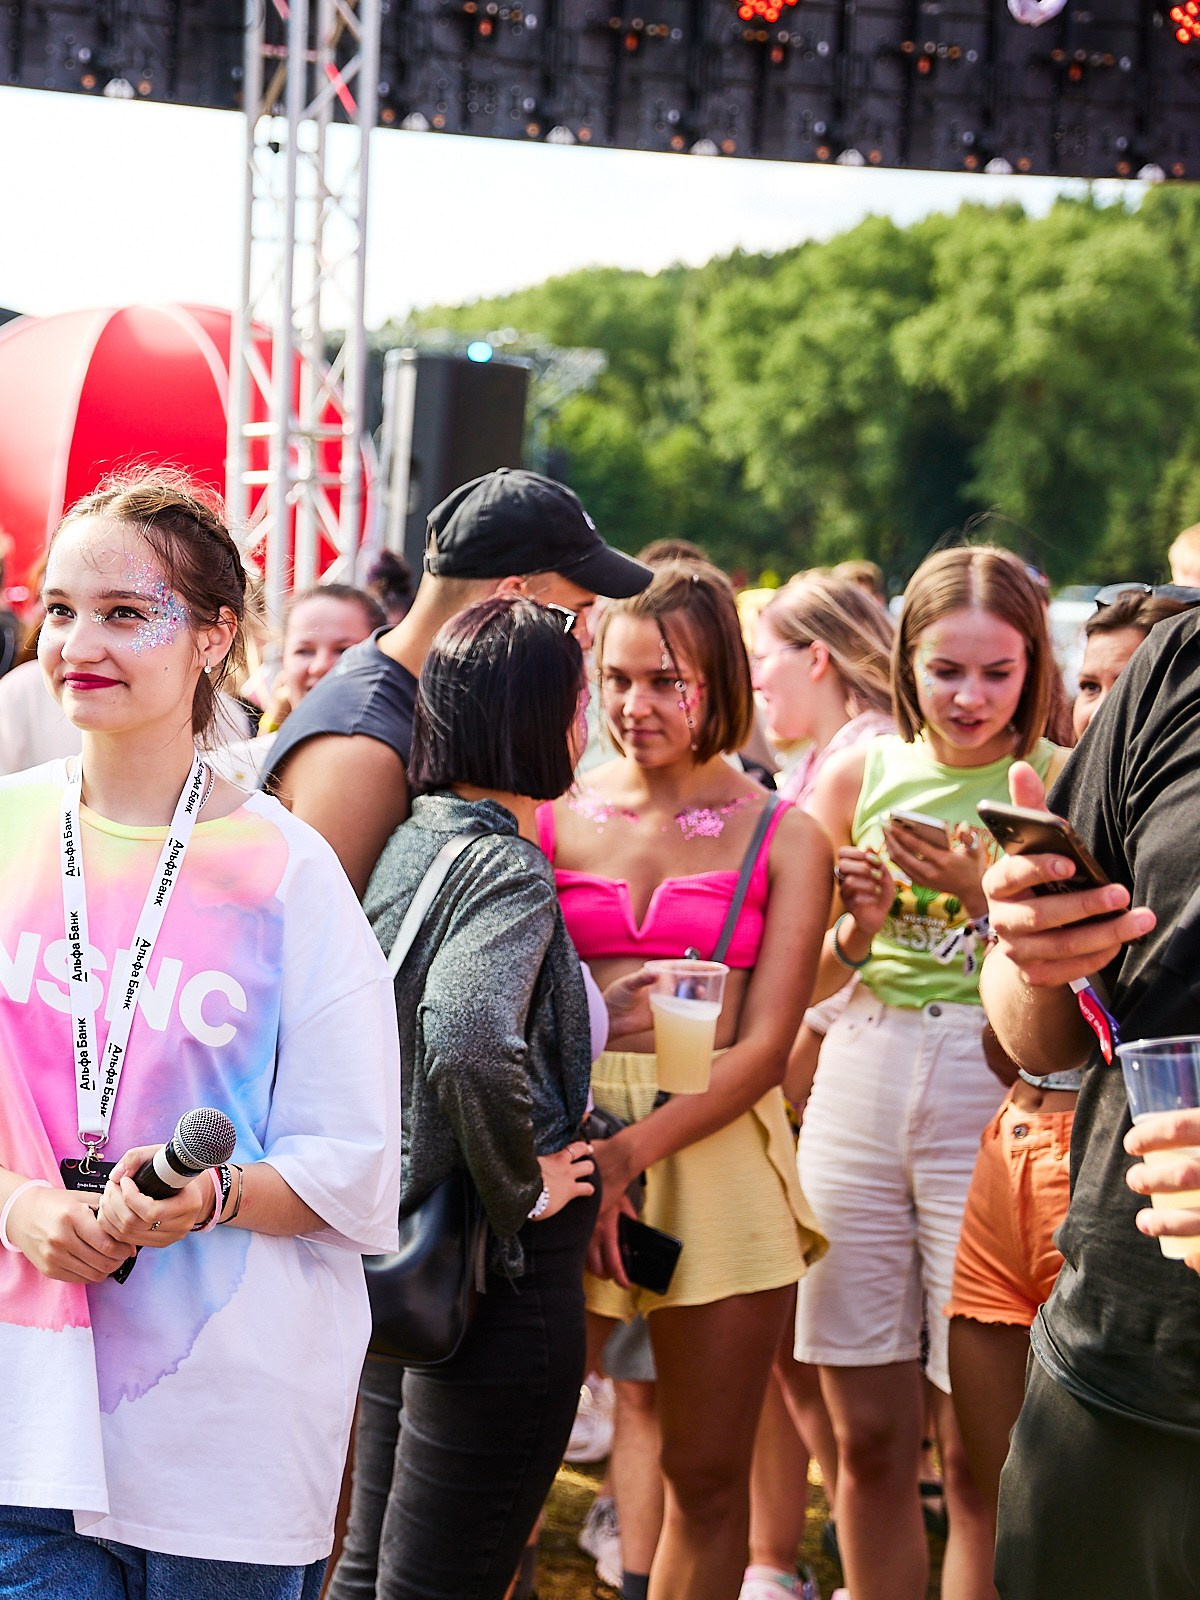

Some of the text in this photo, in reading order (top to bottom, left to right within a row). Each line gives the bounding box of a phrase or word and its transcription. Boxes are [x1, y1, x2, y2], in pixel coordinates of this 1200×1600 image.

[184, 789, 199, 815] Банк
[63, 811, 80, 877] Альфа Банк
[154, 838, 184, 906] Альфа Банк
[68, 911, 88, 982] Альфа Банк
[122, 937, 152, 1010] Альфа Банк
[76, 1018, 95, 1091] Альфа Банк
[105, 1043, 123, 1084] Альфа
